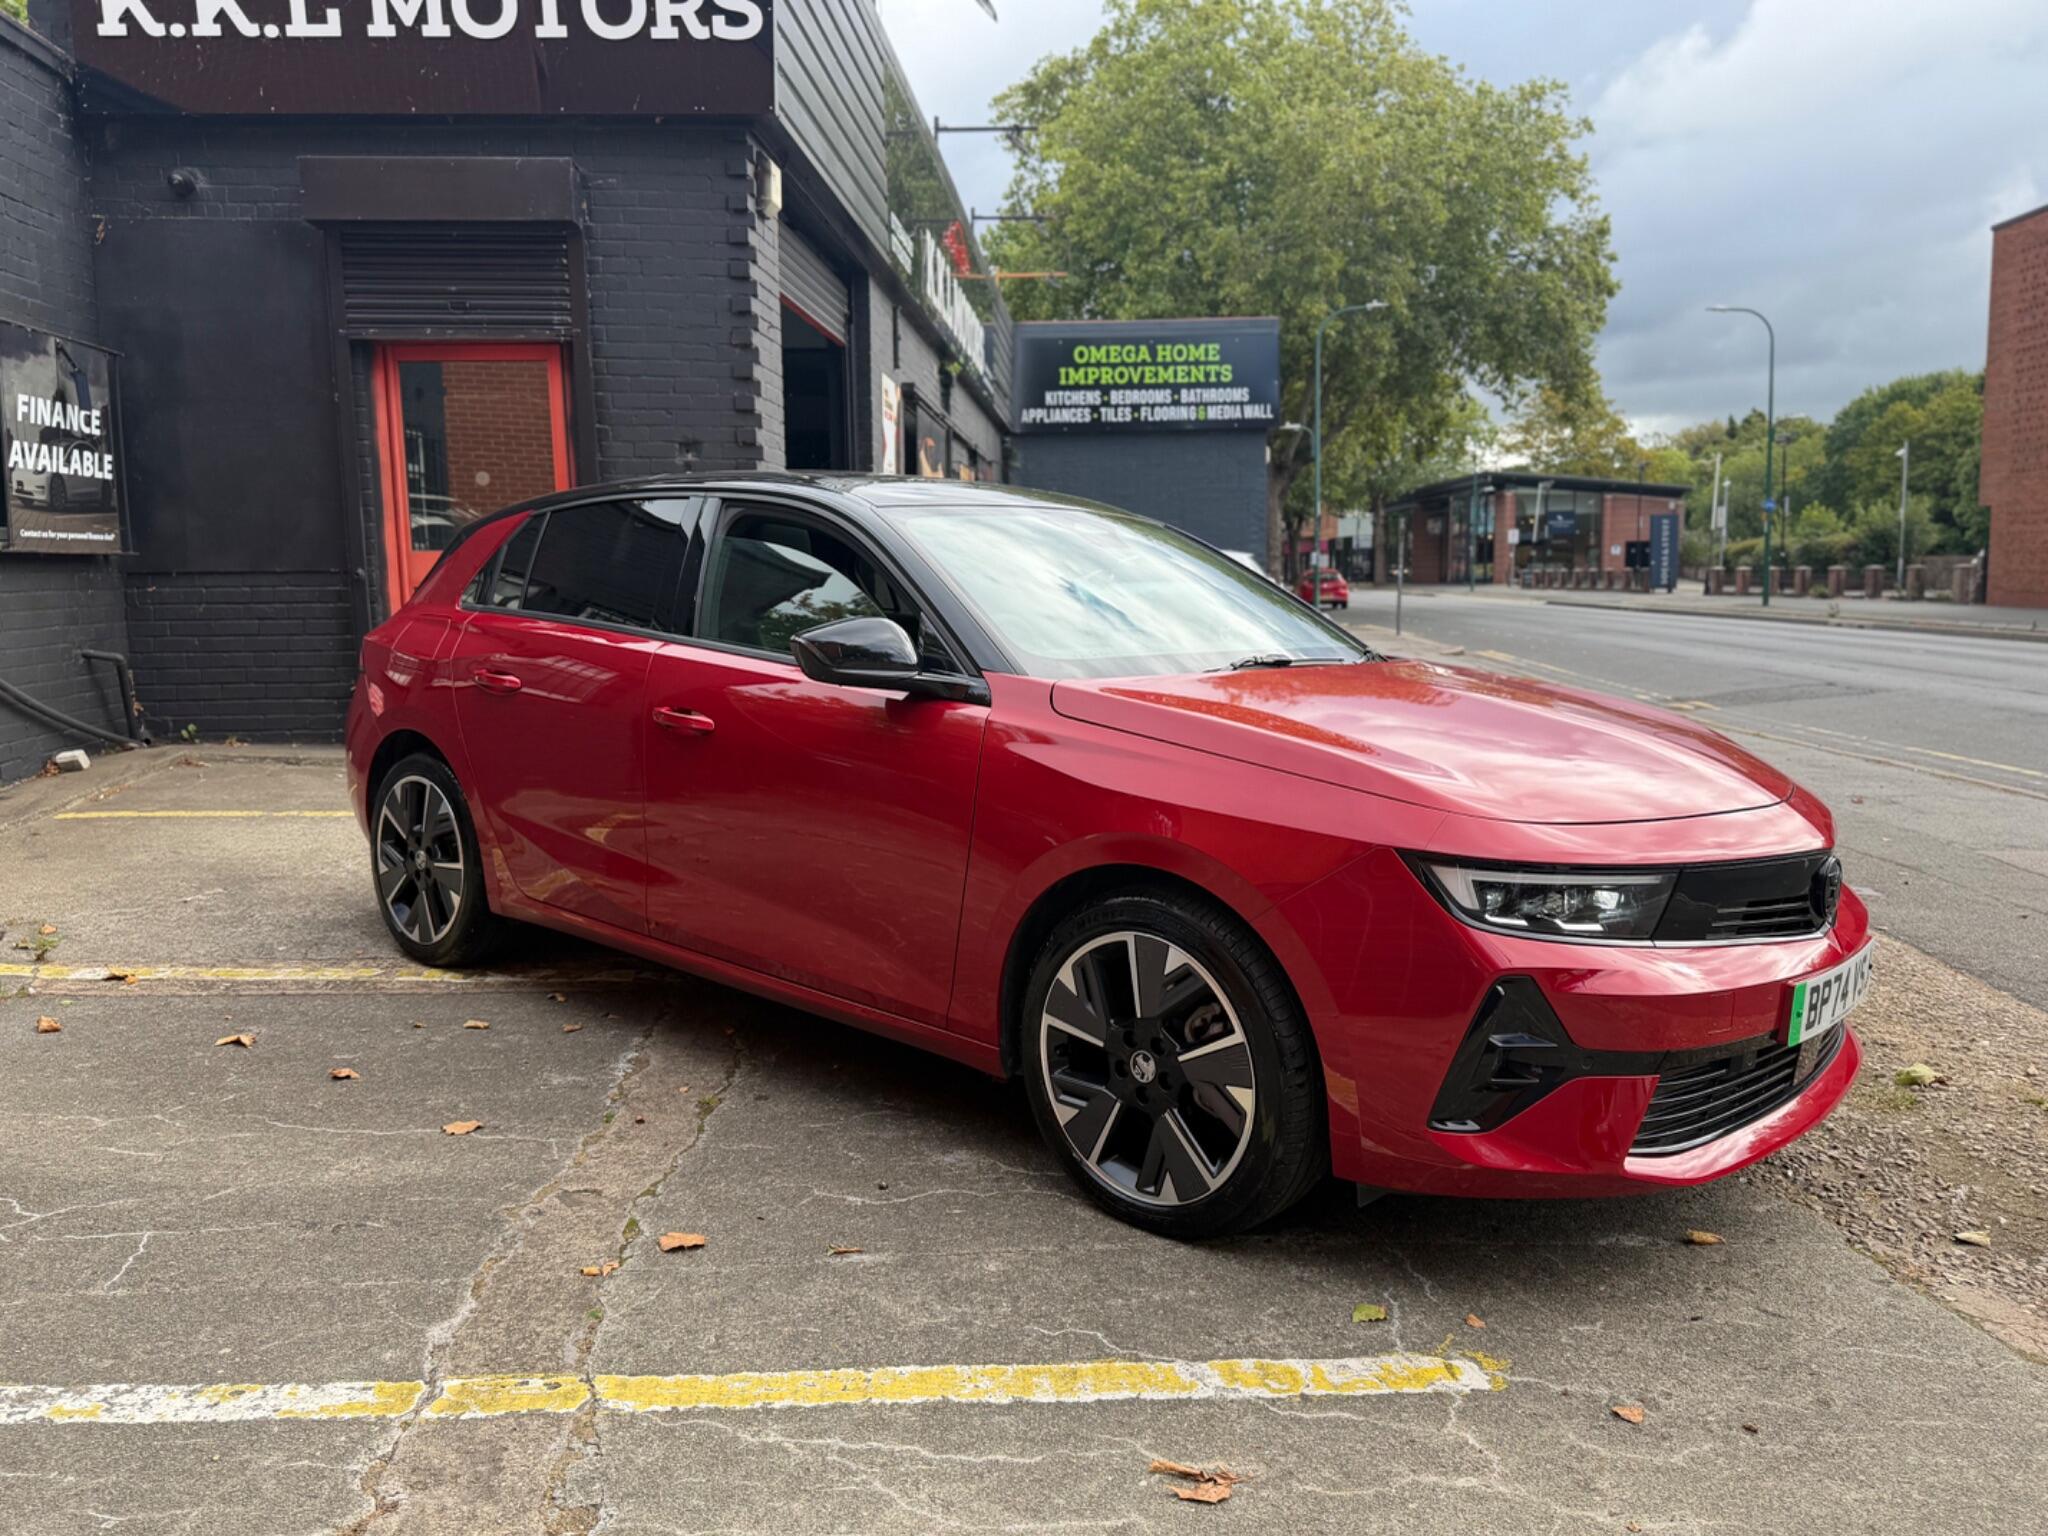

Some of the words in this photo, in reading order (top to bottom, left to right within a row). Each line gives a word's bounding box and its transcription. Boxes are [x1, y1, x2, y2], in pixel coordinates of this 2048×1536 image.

[97, 0, 342, 38] K.K.L
[366, 0, 763, 41] MOTORS
[1073, 345, 1151, 364] OMEGA
[1156, 343, 1221, 362] HOME
[1059, 364, 1233, 386] IMPROVEMENTS
[1045, 390, 1102, 406] KITCHENS
[1110, 388, 1172, 405] BEDROOMS
[1180, 387, 1250, 403] BATHROOMS
[17, 393, 101, 436] FINANCE
[1021, 407, 1092, 424] APPLIANCES
[1100, 407, 1132, 422] TILES
[1140, 405, 1197, 421] FLOORING
[1207, 404, 1243, 420] MEDIA
[1243, 403, 1274, 419] WALL
[8, 440, 113, 480] AVAILABLE
[1805, 966, 1851, 1031] BP74
